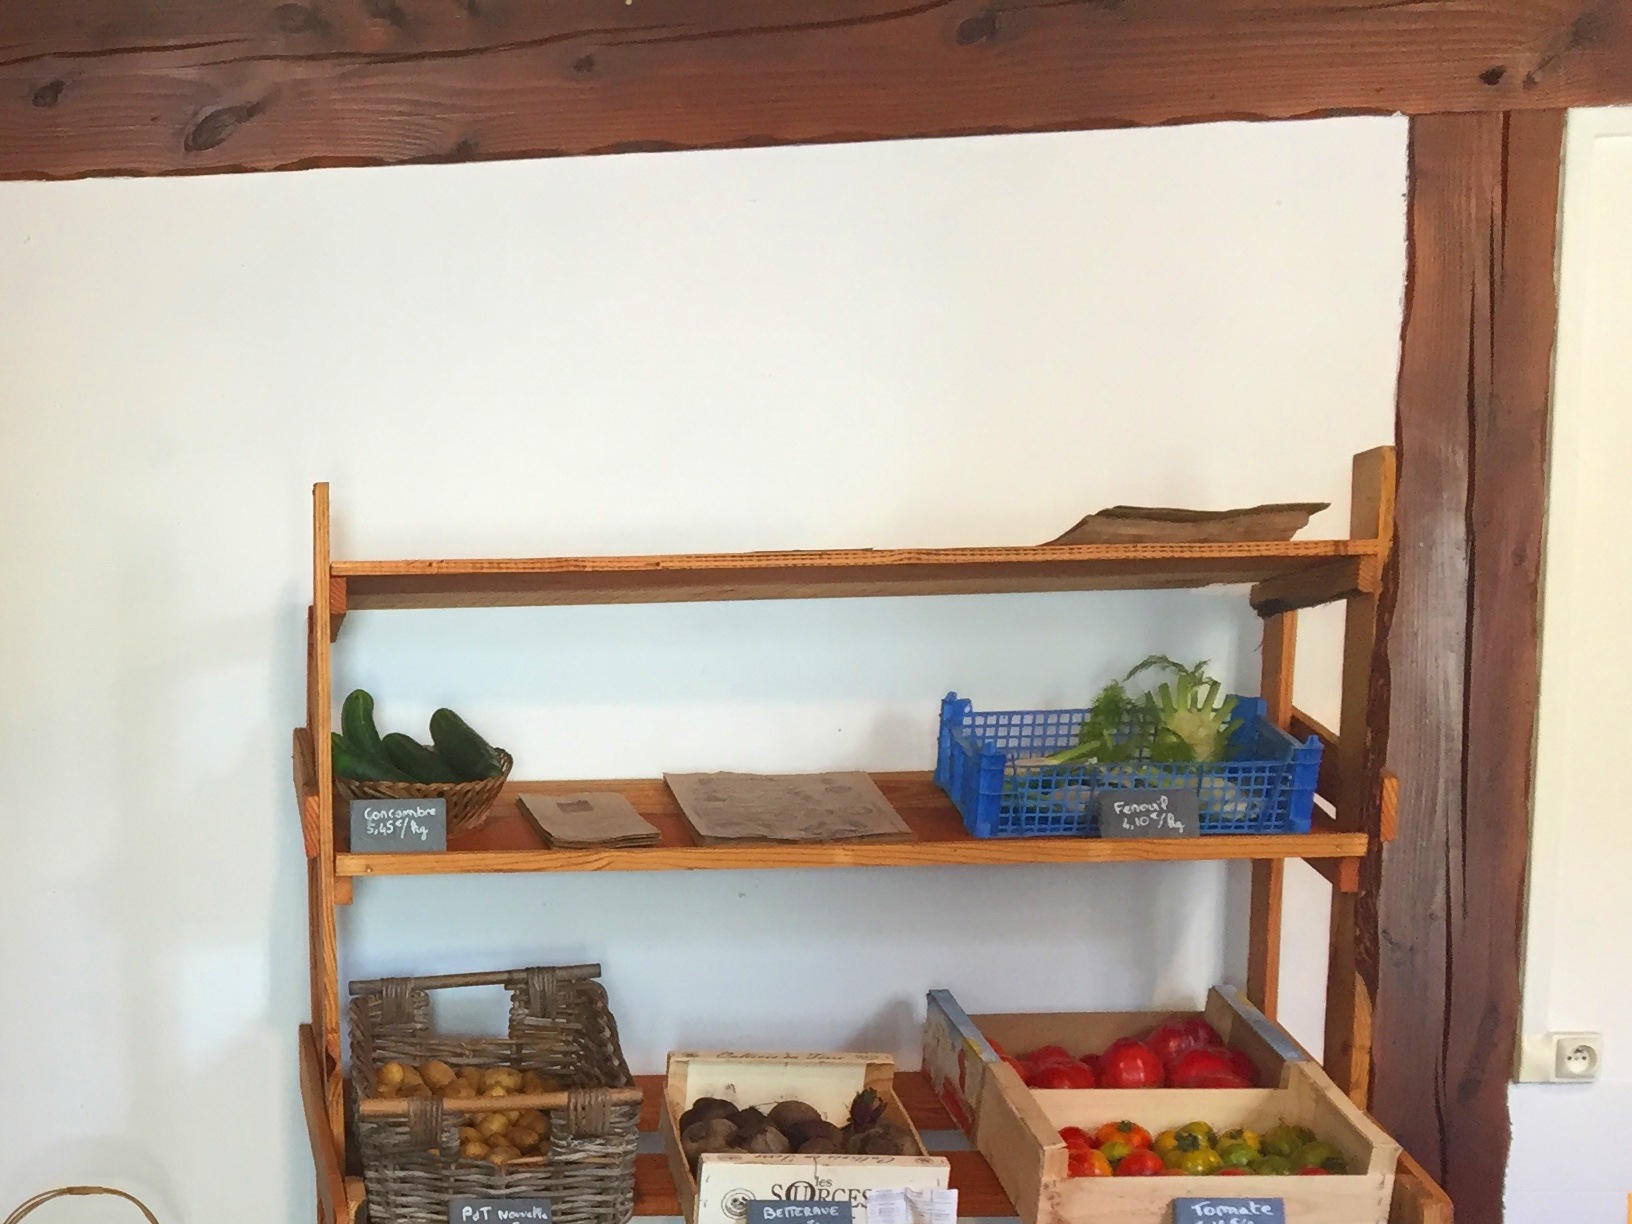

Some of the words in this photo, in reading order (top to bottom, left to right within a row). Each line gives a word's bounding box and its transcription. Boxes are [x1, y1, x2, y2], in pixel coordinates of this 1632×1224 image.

[1113, 795, 1169, 815] Fenouil
[364, 806, 437, 820] Concombre
[815, 1175, 833, 1187] les
[763, 1206, 840, 1219] BETTERAVE
[1191, 1201, 1274, 1217] Tomate
